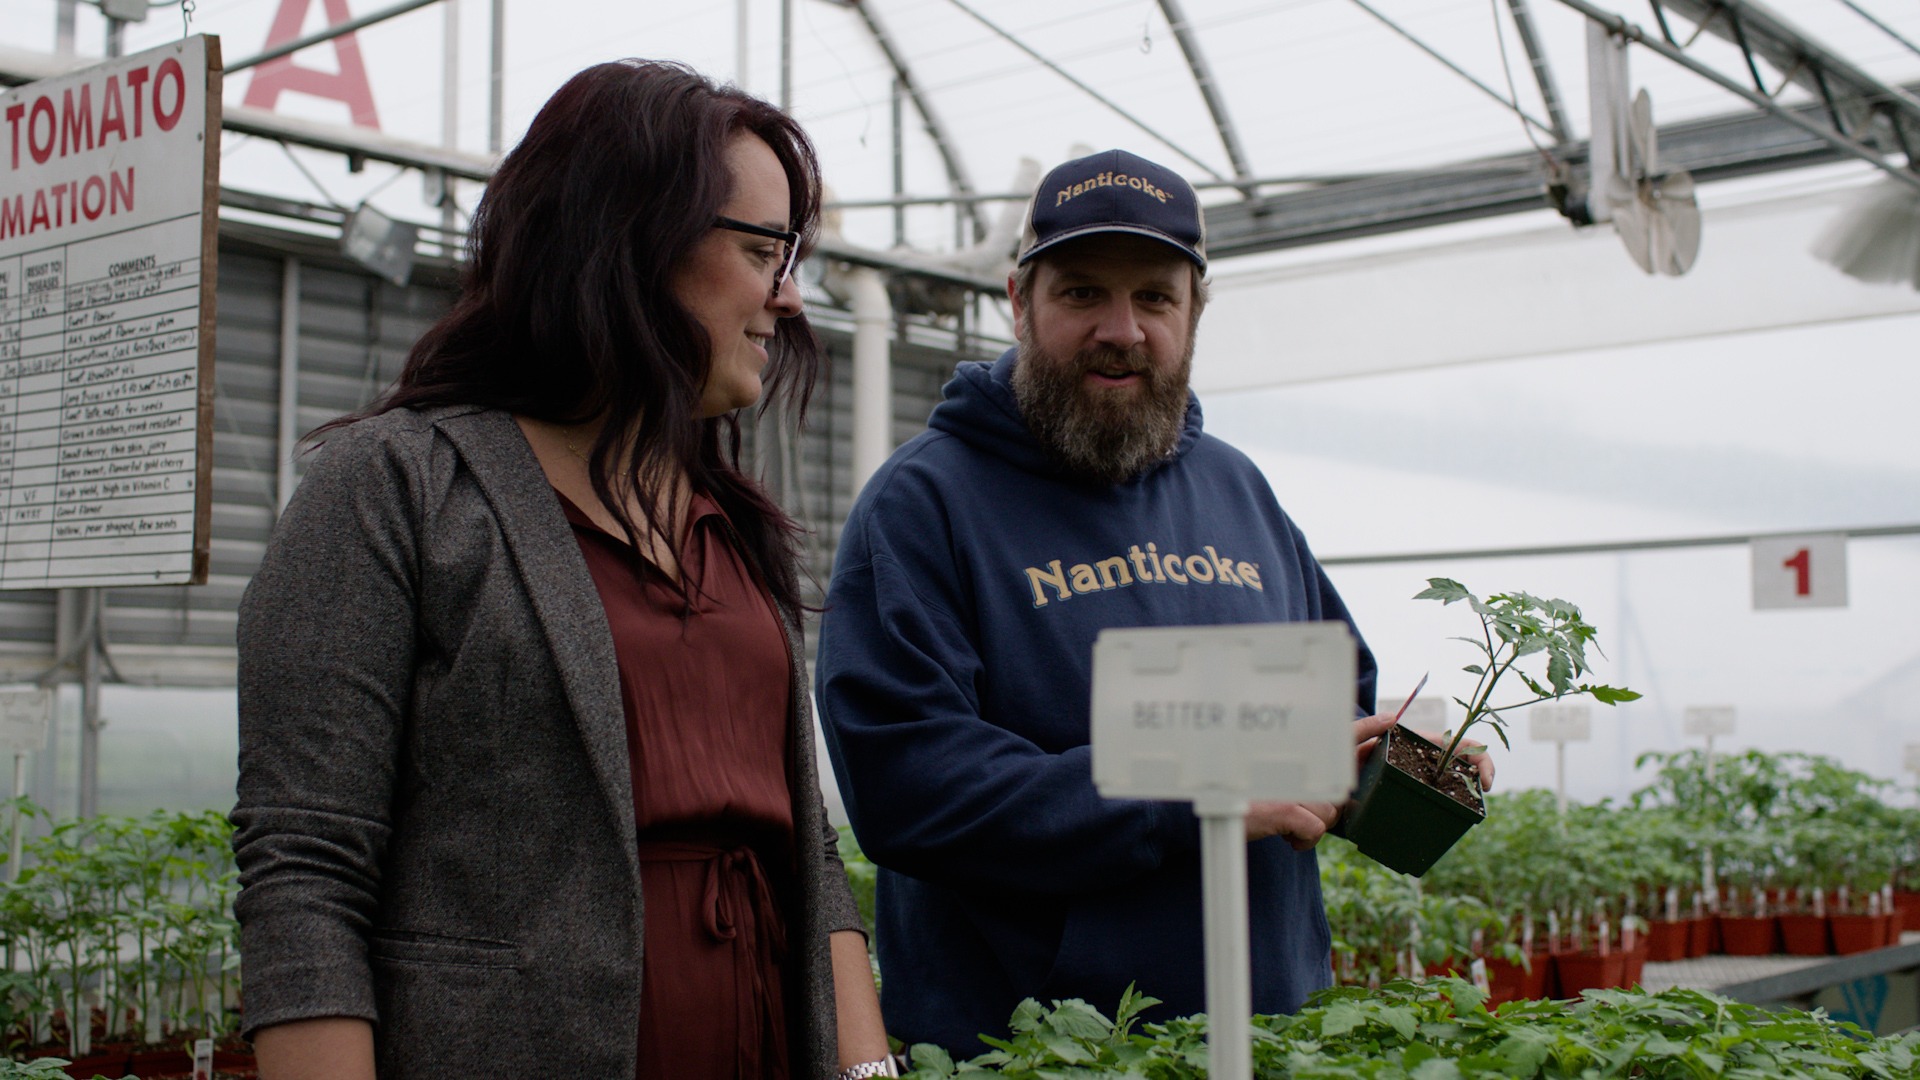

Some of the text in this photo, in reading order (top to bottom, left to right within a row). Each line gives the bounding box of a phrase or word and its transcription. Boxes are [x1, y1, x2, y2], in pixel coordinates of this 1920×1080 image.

[6, 57, 186, 171] TOMATO
[108, 254, 157, 278] COMMENTS
[133, 479, 162, 491] Vitamin
[164, 478, 170, 490] C
[1024, 542, 1264, 608] Nanticoke
[1783, 548, 1811, 596] 1
[1132, 702, 1294, 730] BETTER BOY
